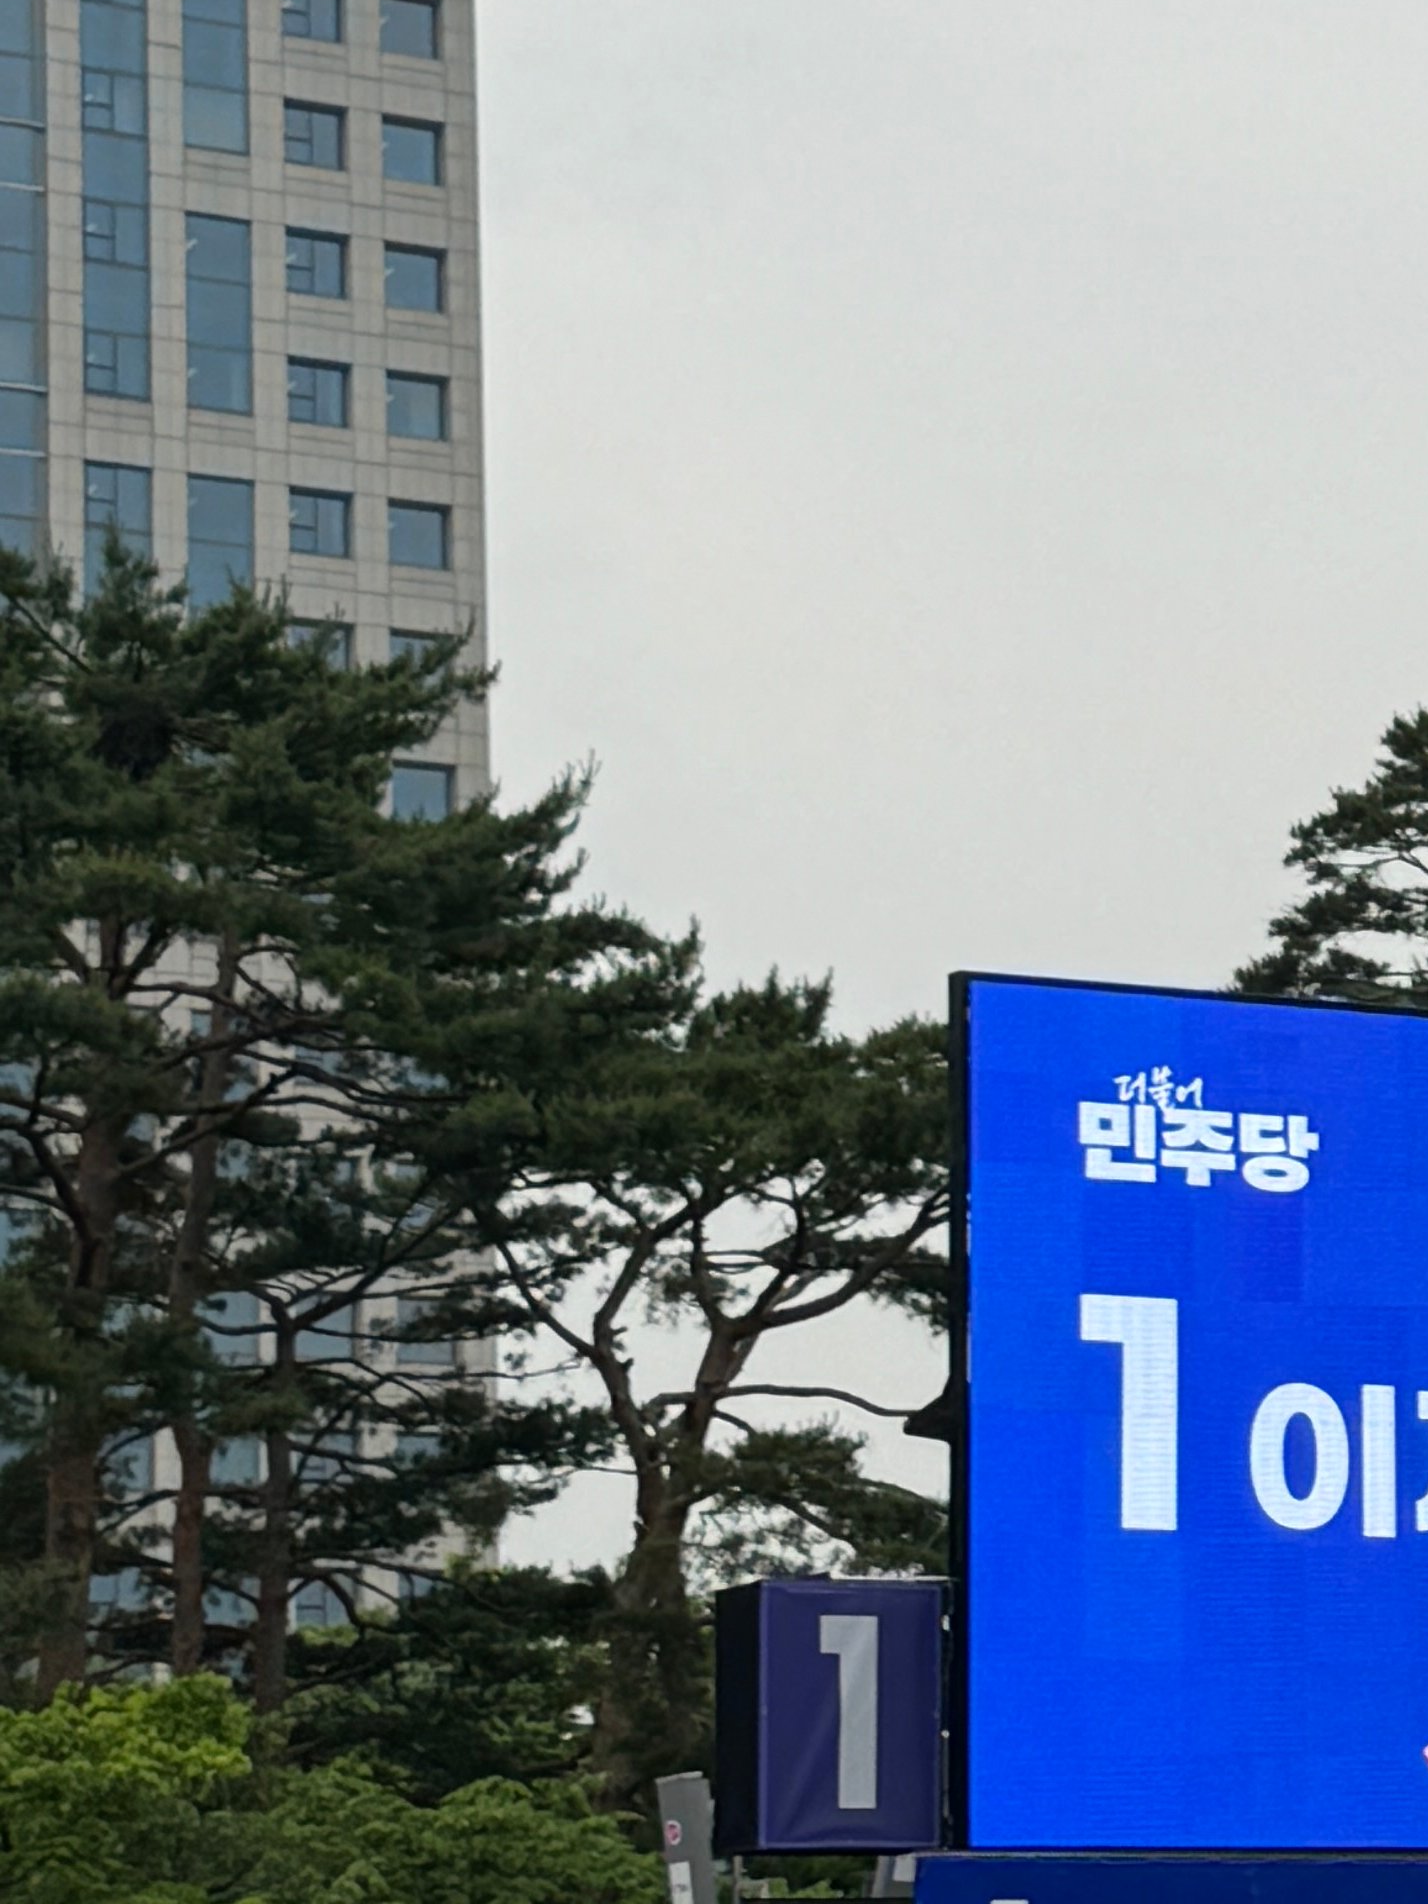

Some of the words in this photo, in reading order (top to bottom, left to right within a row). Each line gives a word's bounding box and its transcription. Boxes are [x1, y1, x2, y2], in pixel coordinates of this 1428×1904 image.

[1078, 1100, 1320, 1193] 민주당
[1114, 1065, 1204, 1110] 더불어
[1080, 1293, 1178, 1532] 1
[819, 1614, 879, 1810] 1
